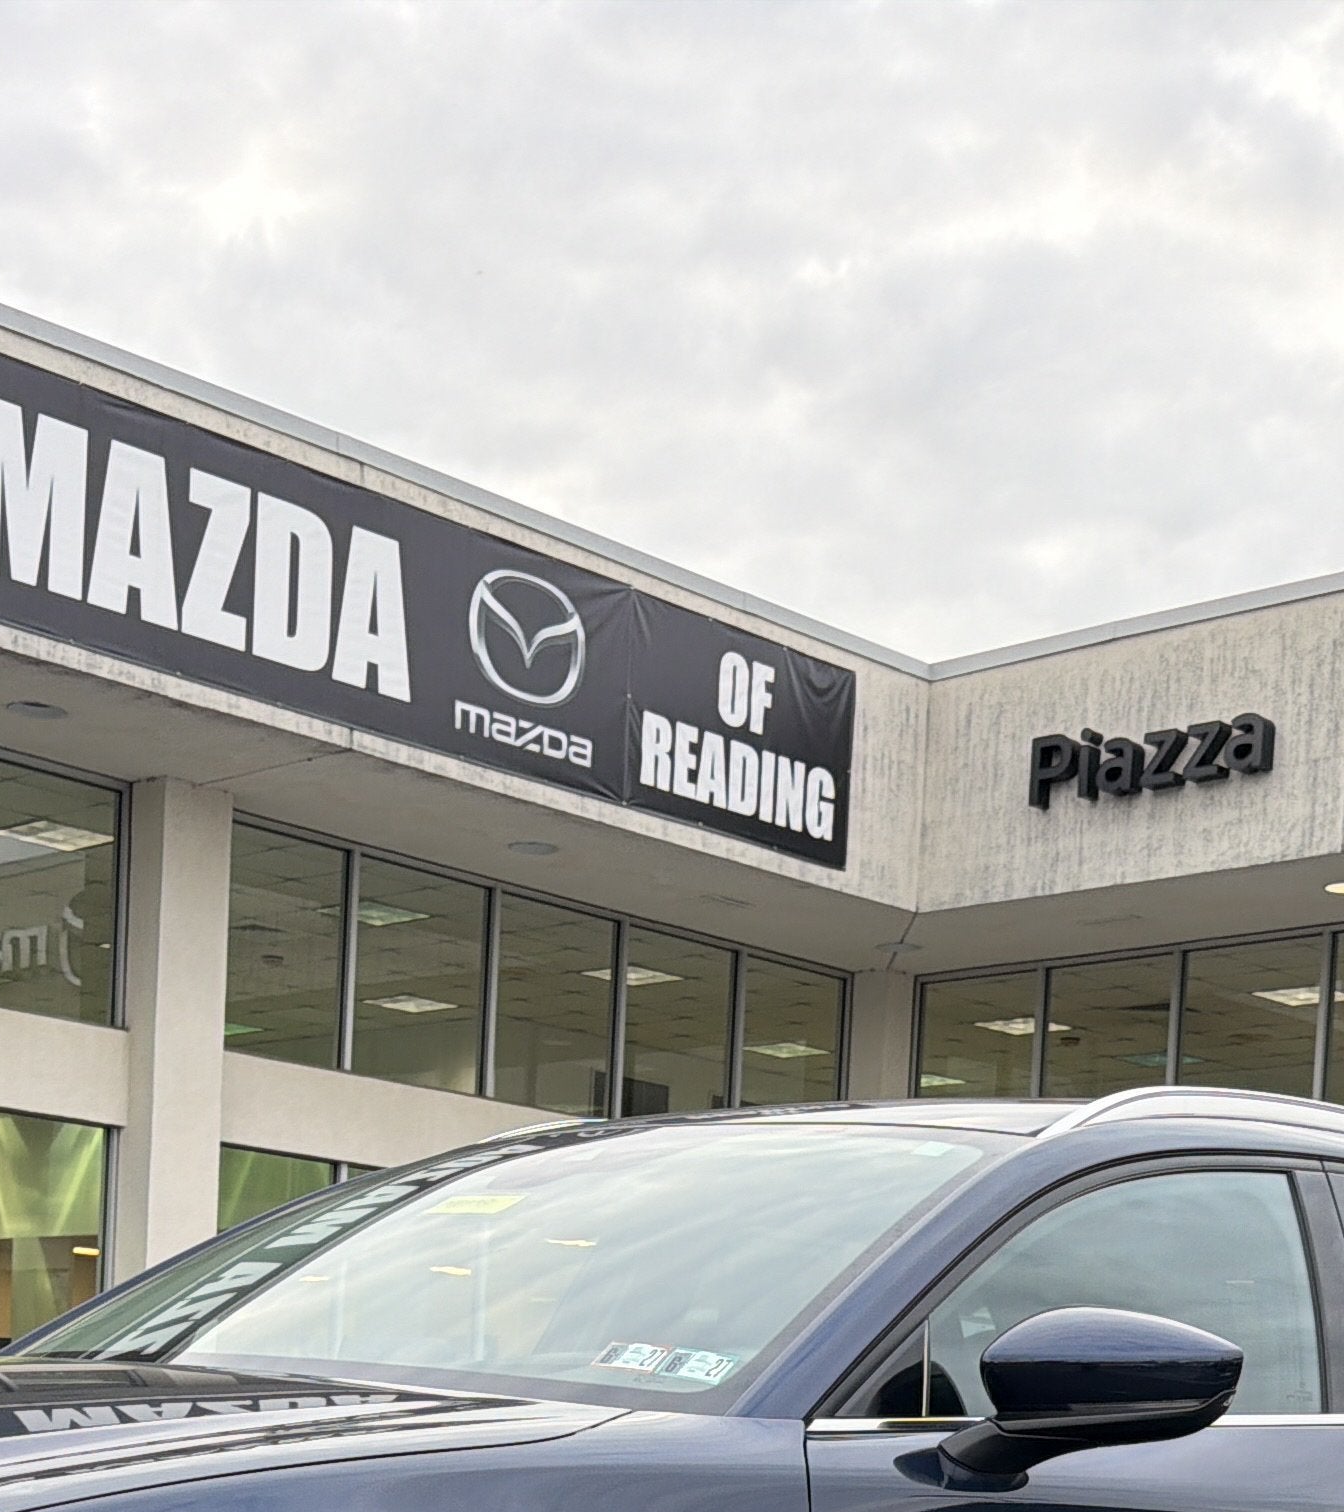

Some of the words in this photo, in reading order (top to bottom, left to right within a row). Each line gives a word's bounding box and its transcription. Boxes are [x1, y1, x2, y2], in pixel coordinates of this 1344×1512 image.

[454, 699, 592, 768] mazda
[717, 650, 775, 734] OF
[639, 709, 835, 842] READING
[1027, 712, 1275, 809] Piazza
